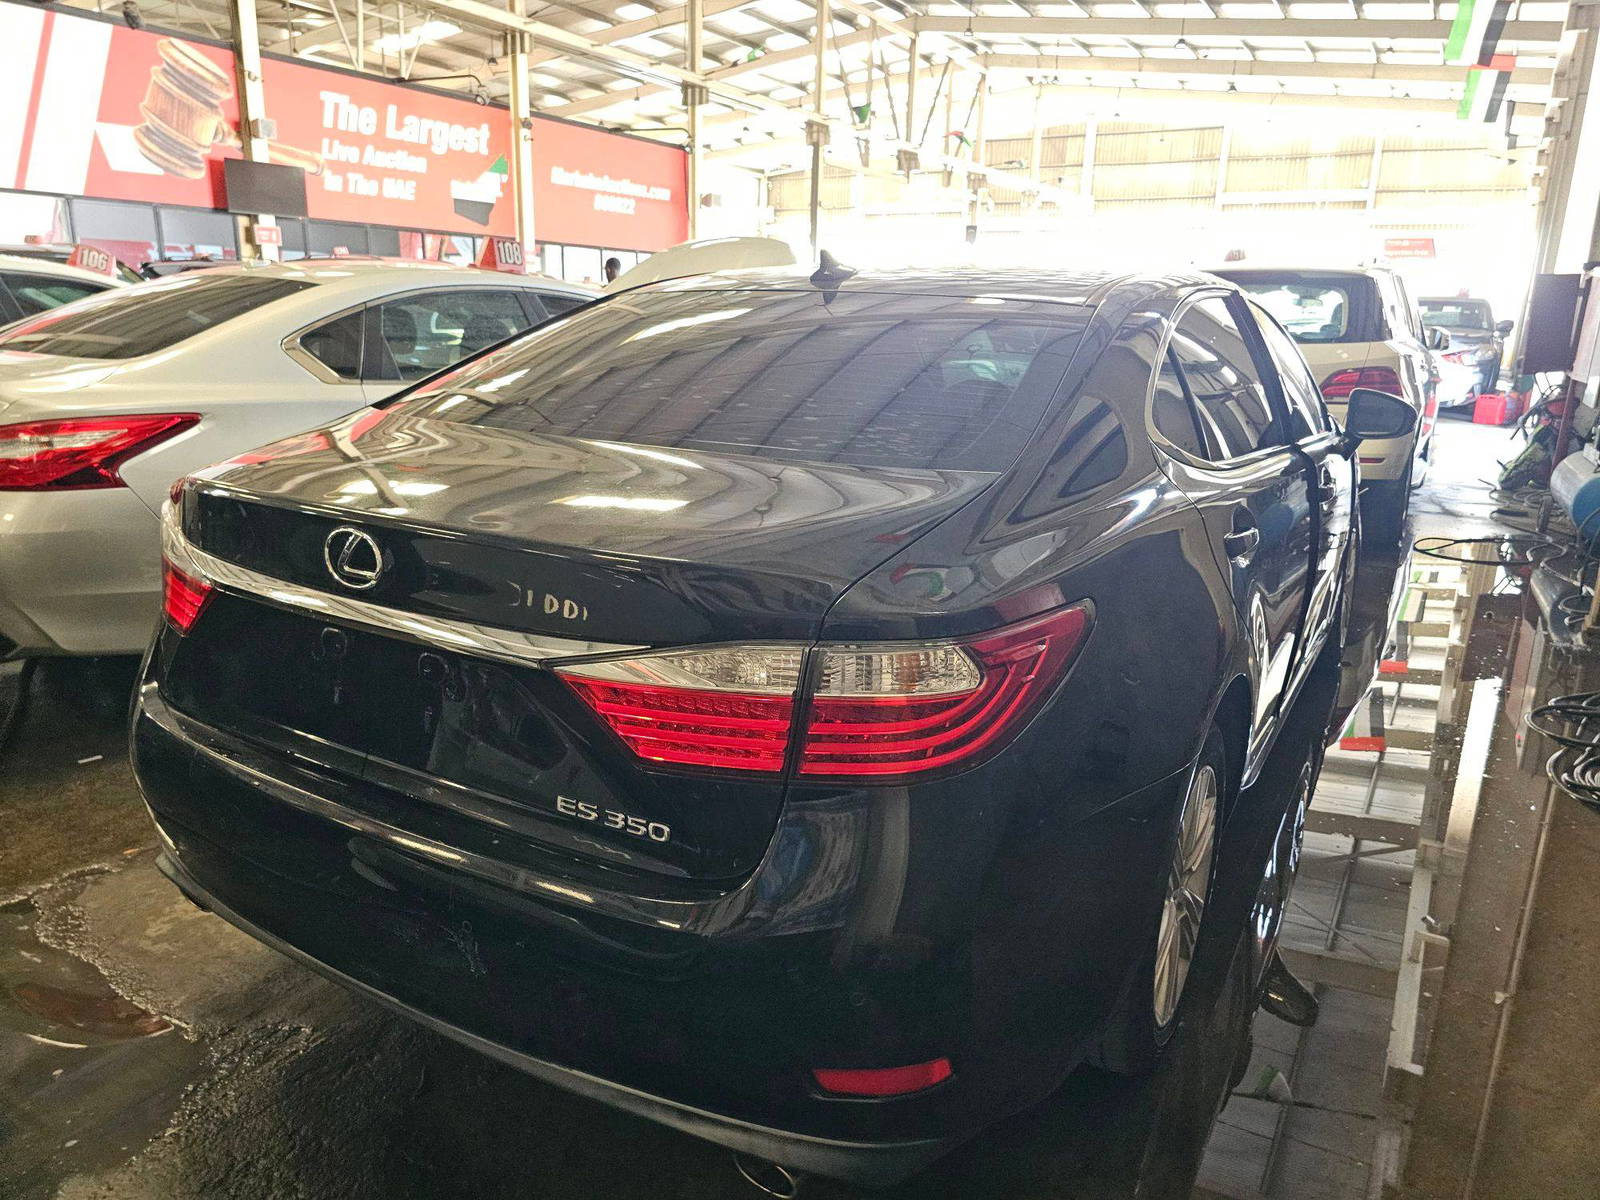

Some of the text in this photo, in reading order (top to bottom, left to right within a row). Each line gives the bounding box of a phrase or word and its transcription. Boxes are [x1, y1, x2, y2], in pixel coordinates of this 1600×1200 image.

[320, 90, 490, 155] The Largest
[322, 138, 428, 174] Live Auction
[324, 169, 416, 201] In The UAE
[81, 247, 108, 271] 106
[498, 241, 523, 265] 108
[556, 795, 671, 842] ES 350
